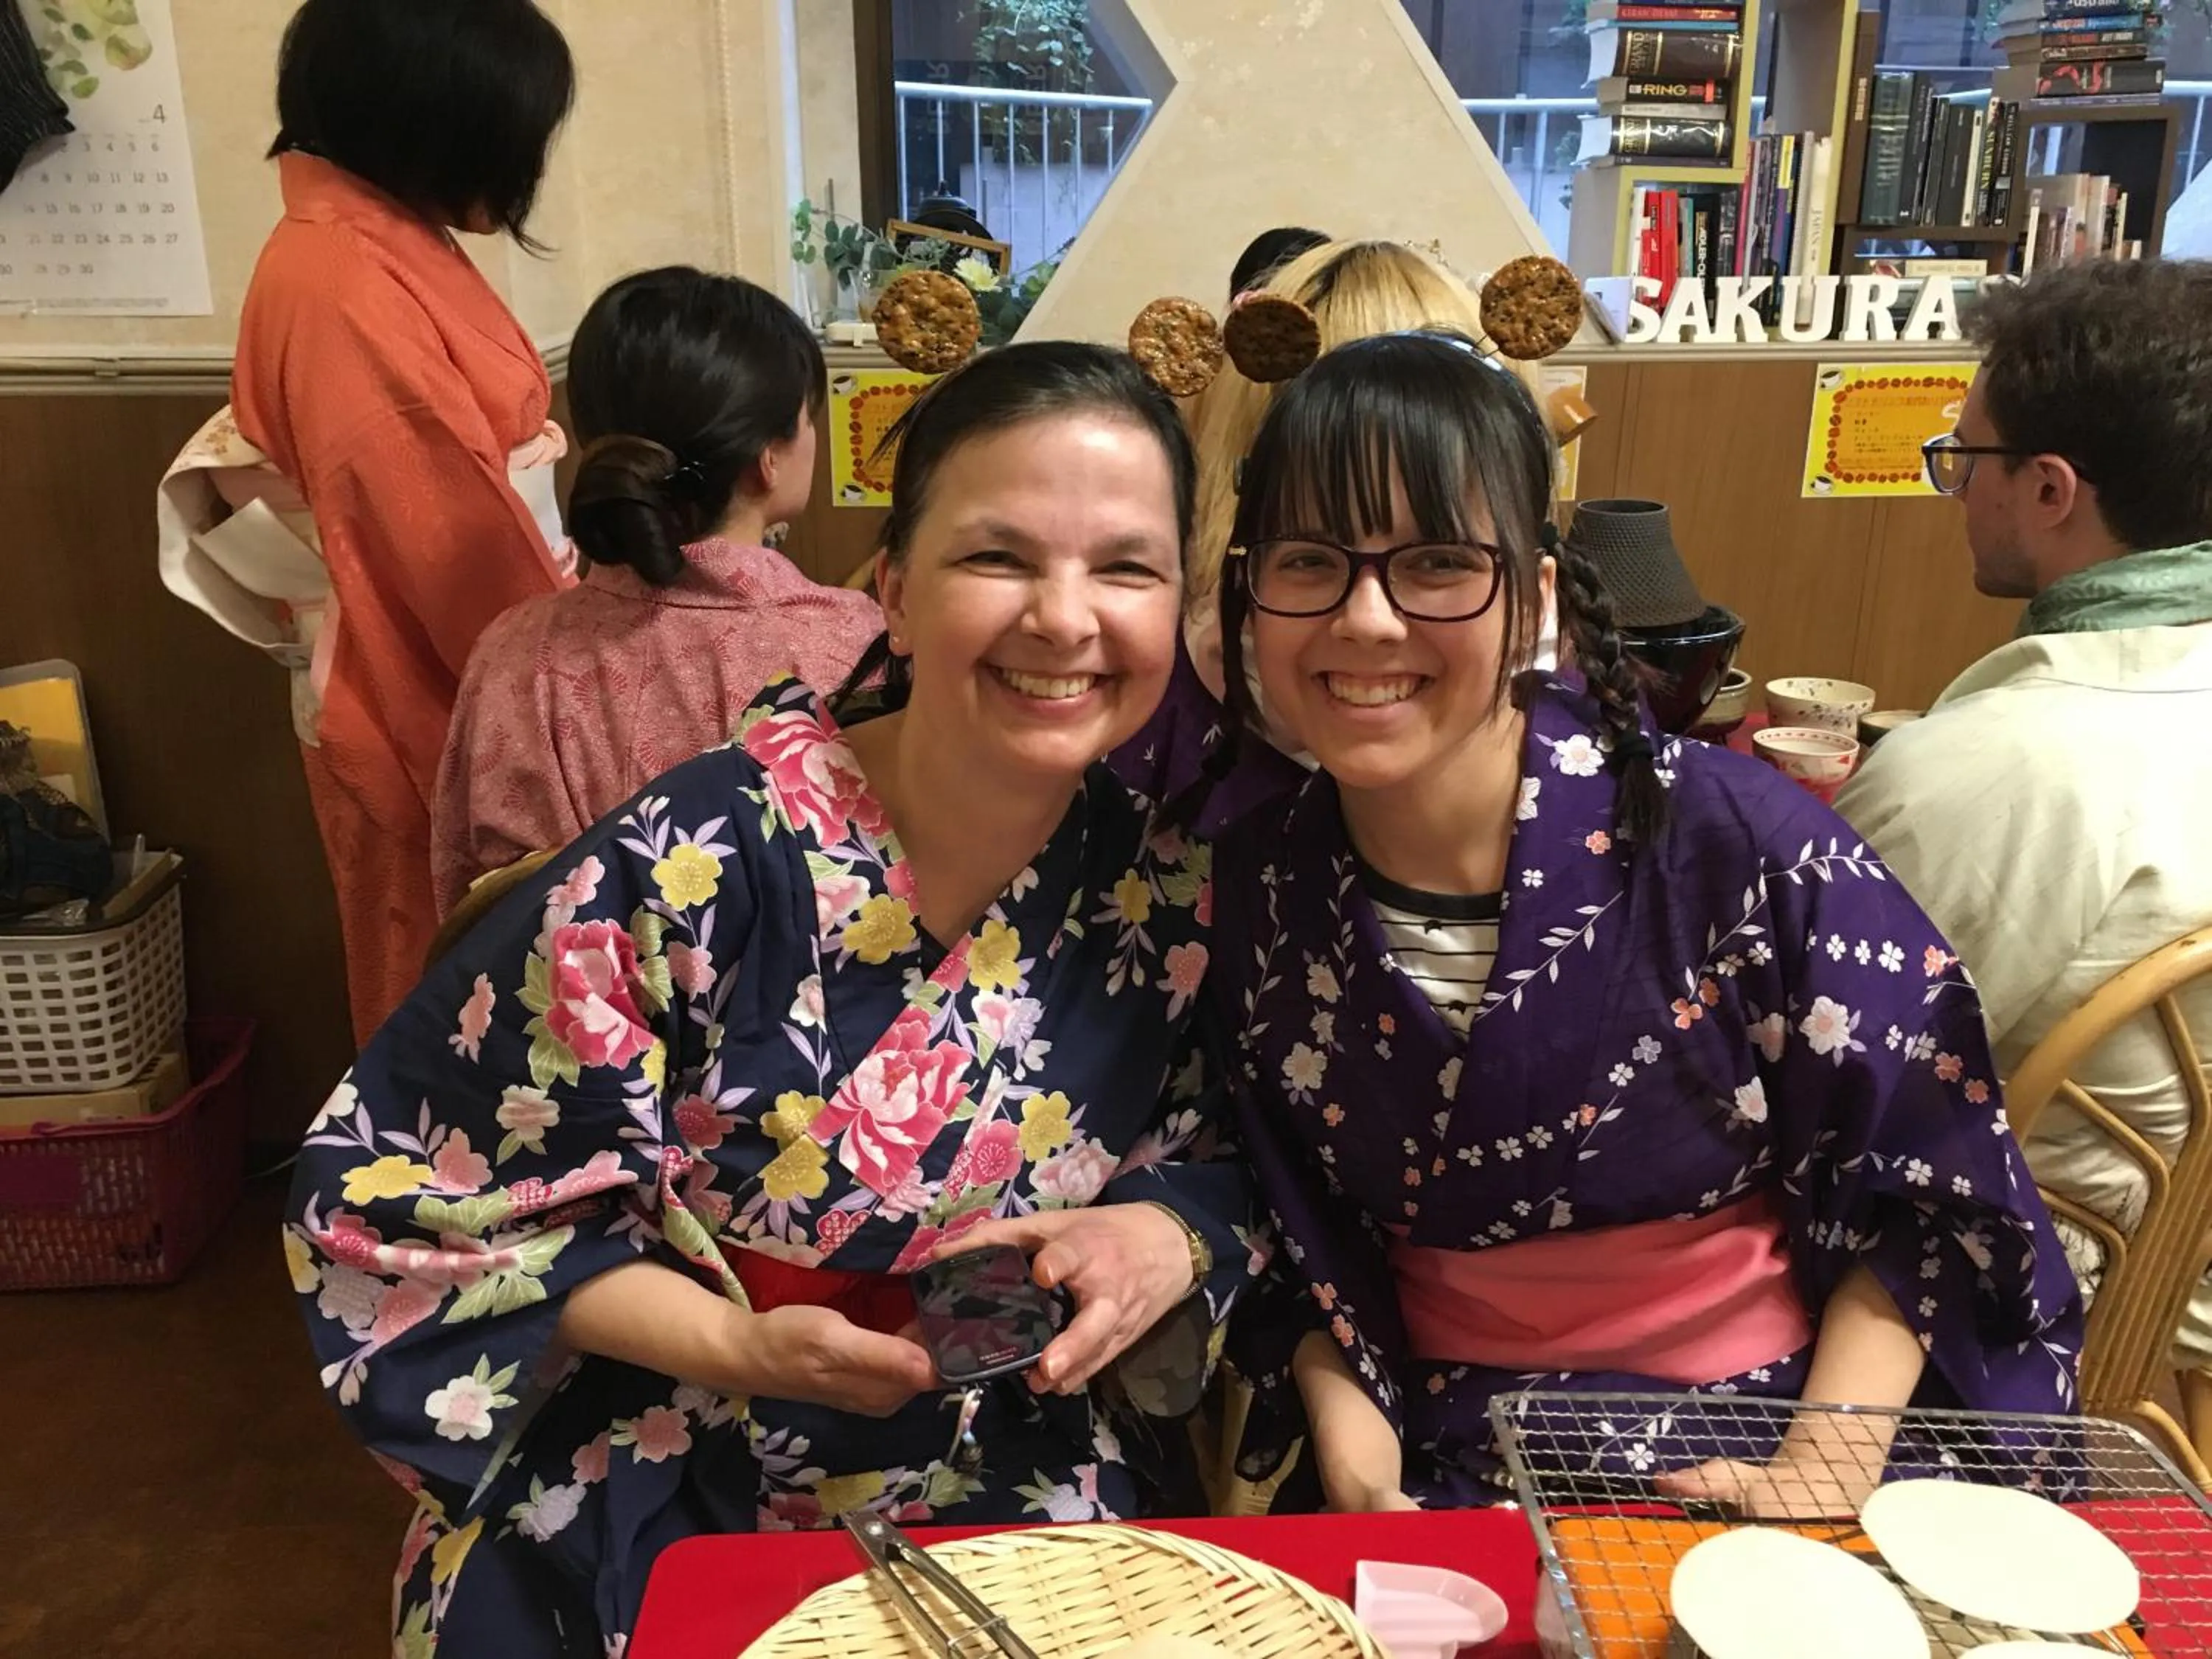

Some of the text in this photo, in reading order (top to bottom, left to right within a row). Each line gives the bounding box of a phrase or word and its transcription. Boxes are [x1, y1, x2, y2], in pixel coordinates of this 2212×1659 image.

[1643, 83, 1688, 97] RING
[153, 104, 165, 125] 4
[1980, 130, 1996, 190] SUNBURN
[87, 172, 100, 183] 10
[110, 172, 121, 183] 11
[133, 172, 145, 183] 12
[156, 172, 169, 183] 13
[91, 203, 103, 214] 17
[115, 203, 127, 214] 18
[161, 203, 175, 214] 20
[74, 234, 88, 245] 23
[96, 234, 111, 245] 24
[119, 234, 133, 245] 25
[142, 234, 157, 245] 26
[165, 234, 178, 245] 27
[1624, 275, 1963, 343] SAKURA
